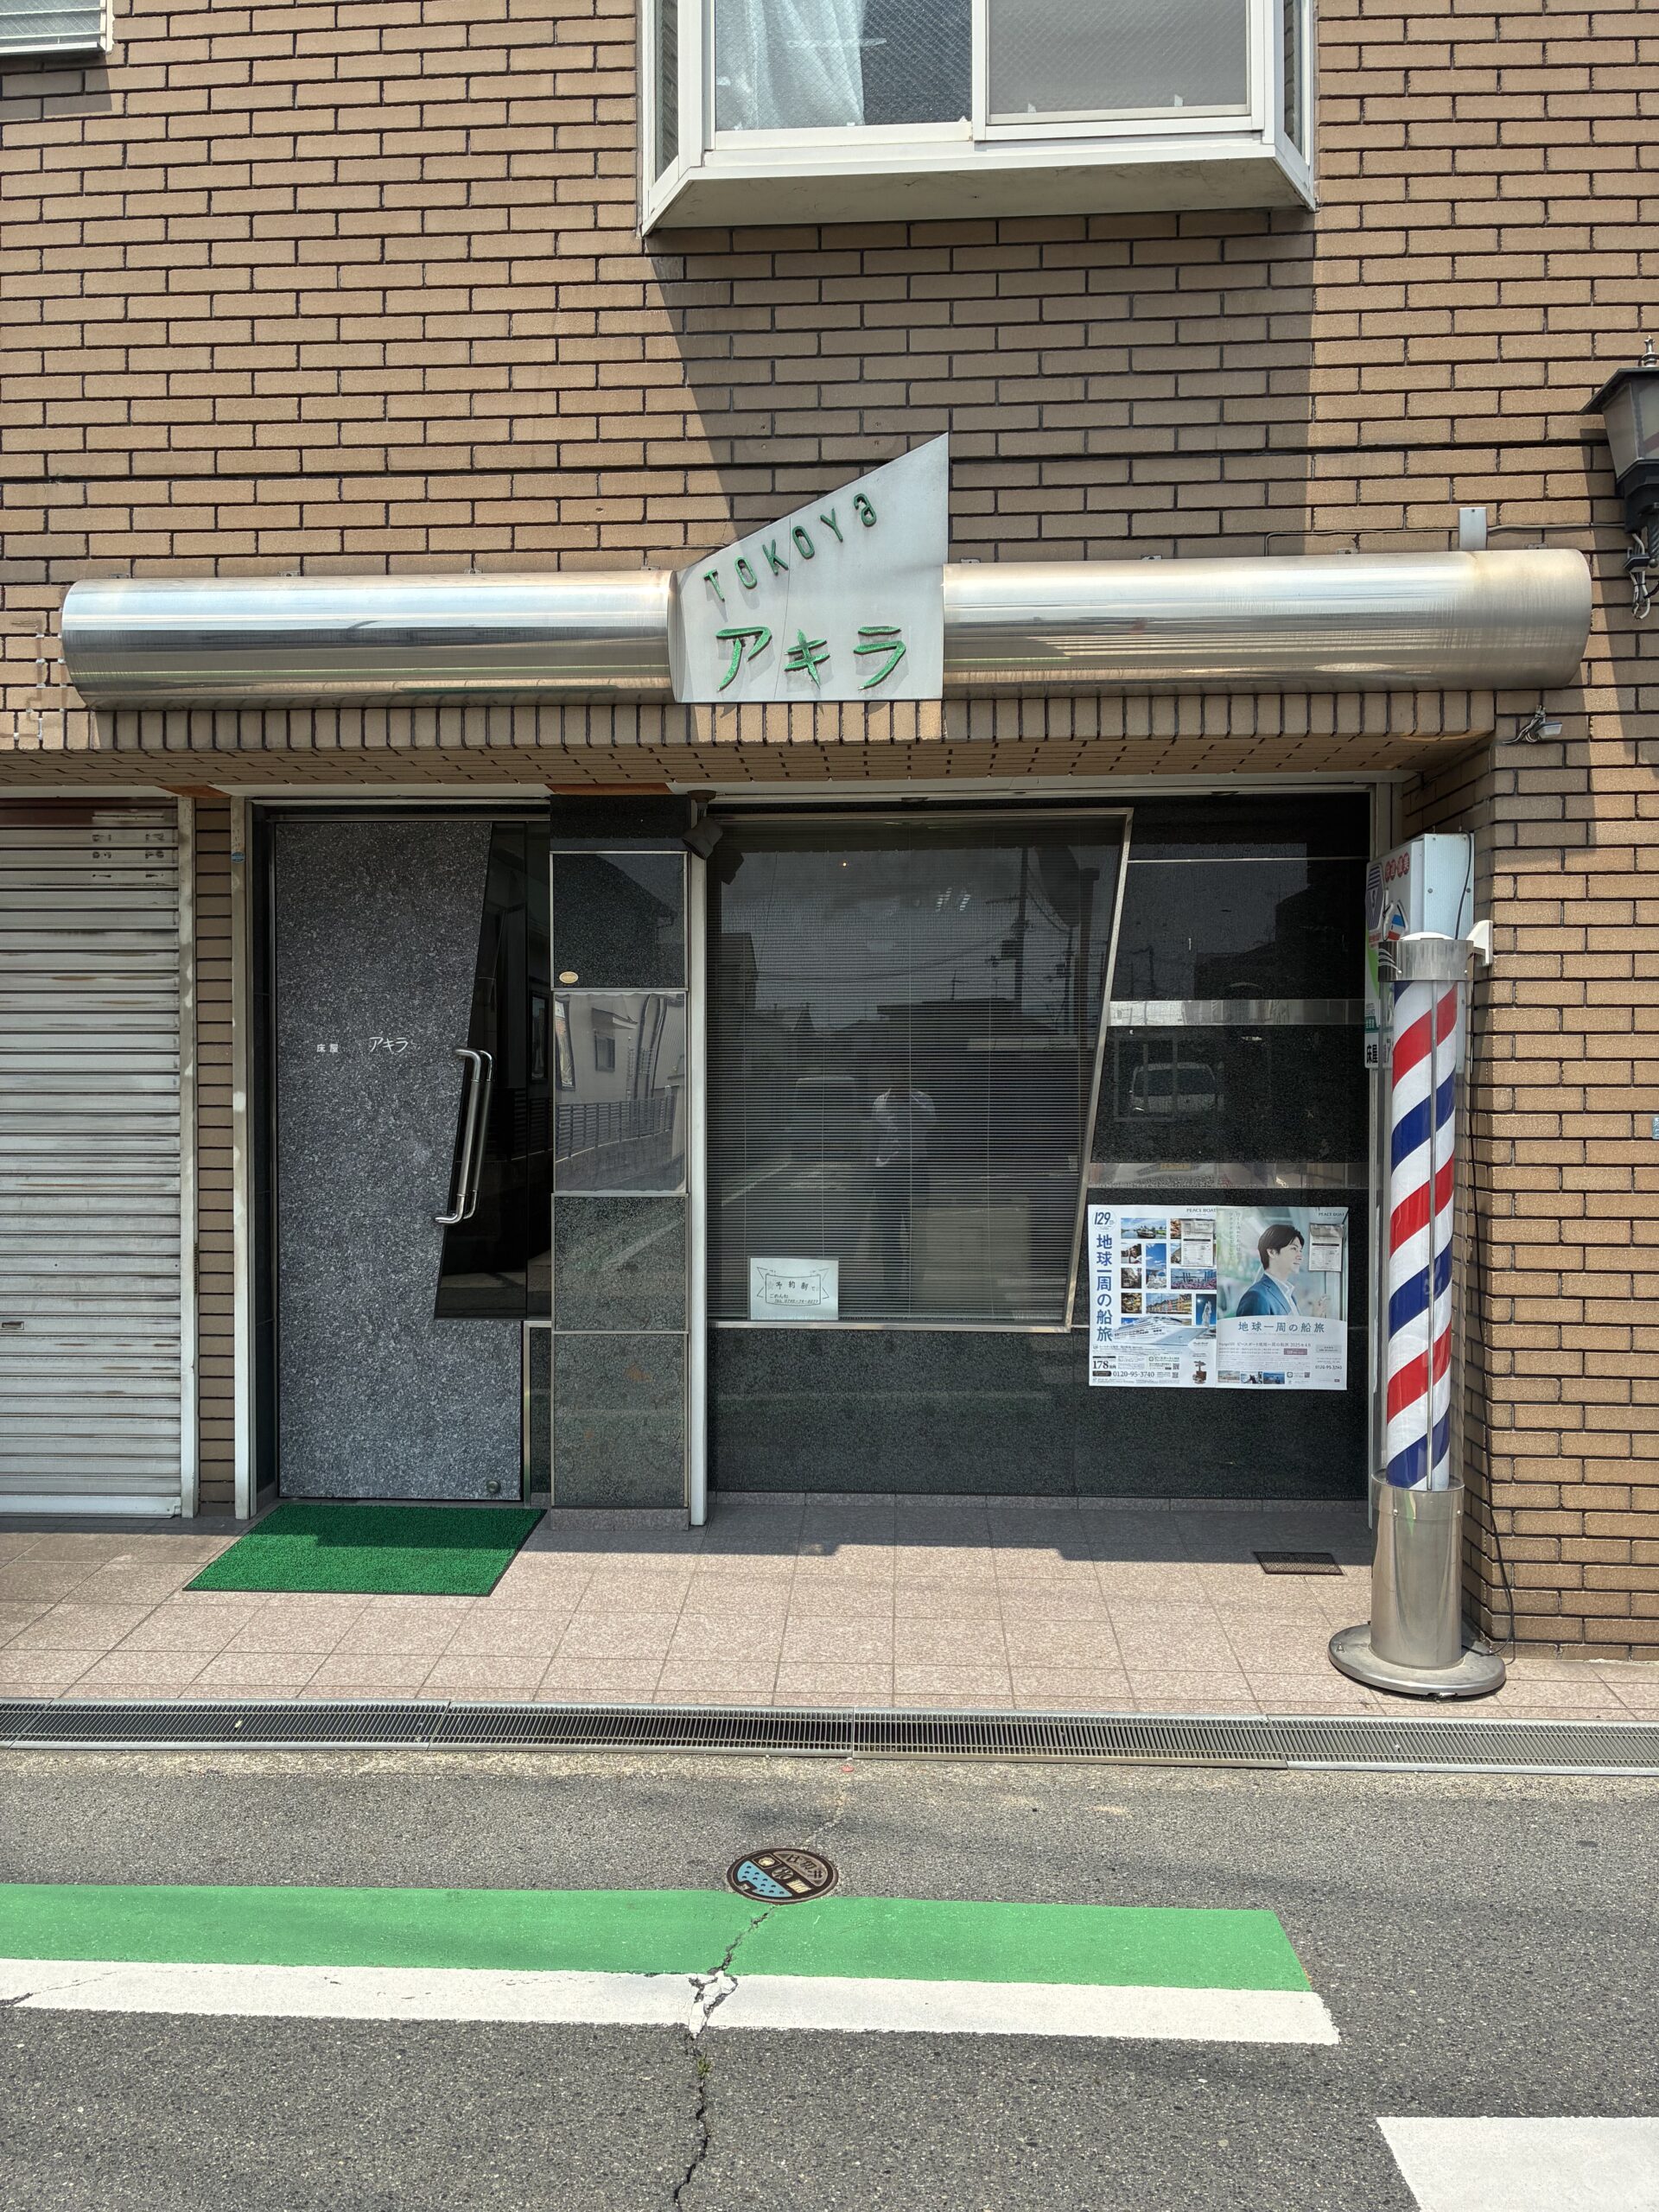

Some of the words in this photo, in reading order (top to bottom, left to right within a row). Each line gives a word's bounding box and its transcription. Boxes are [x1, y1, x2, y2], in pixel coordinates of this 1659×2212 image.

[715, 626, 906, 692] アキラ
[316, 1043, 339, 1053] 床屋
[368, 1036, 409, 1054] アキラ
[1094, 1211, 1111, 1225] 129
[1096, 1233, 1113, 1343] 地球一周の船旅
[1238, 1321, 1325, 1333] 地球一周の船旅
[1112, 1370, 1155, 1378] 0120-95-3740
